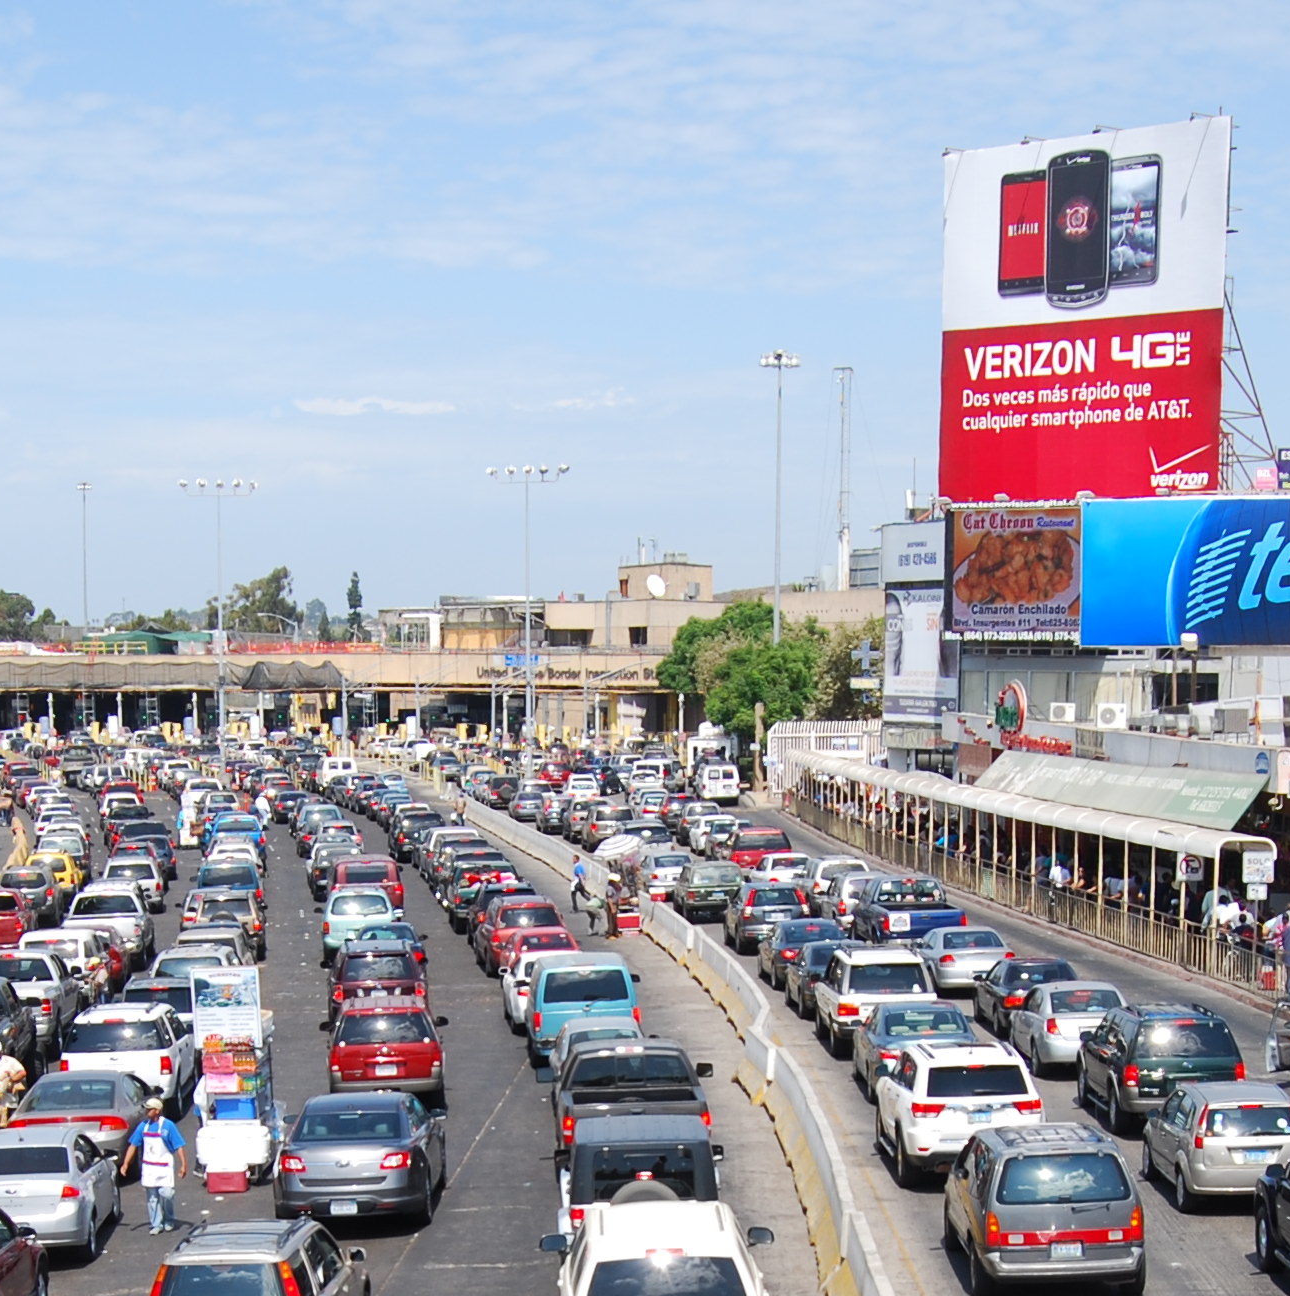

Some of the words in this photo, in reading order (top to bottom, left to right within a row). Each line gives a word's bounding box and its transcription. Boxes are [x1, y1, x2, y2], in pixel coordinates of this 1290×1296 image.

[964, 337, 1097, 381] VERIZON
[1111, 331, 1175, 369] 4G
[962, 388, 991, 408] Dos
[994, 387, 1035, 406] veces
[1037, 383, 1070, 404] más
[1072, 379, 1121, 405] rápido
[1123, 382, 1152, 404] que
[962, 408, 1027, 433] cualquier
[1031, 404, 1121, 430] smartphone
[1124, 402, 1145, 421] de
[1147, 398, 1193, 420] AT&T.
[1150, 469, 1209, 490] verizon
[950, 498, 1077, 509] www.tecnovisiondigital.c
[971, 603, 1015, 615] Camarón
[1018, 602, 1067, 615] Enchilado
[973, 618, 1016, 629] Insurgentes
[477, 667, 508, 679] United
[548, 668, 582, 680] Border
